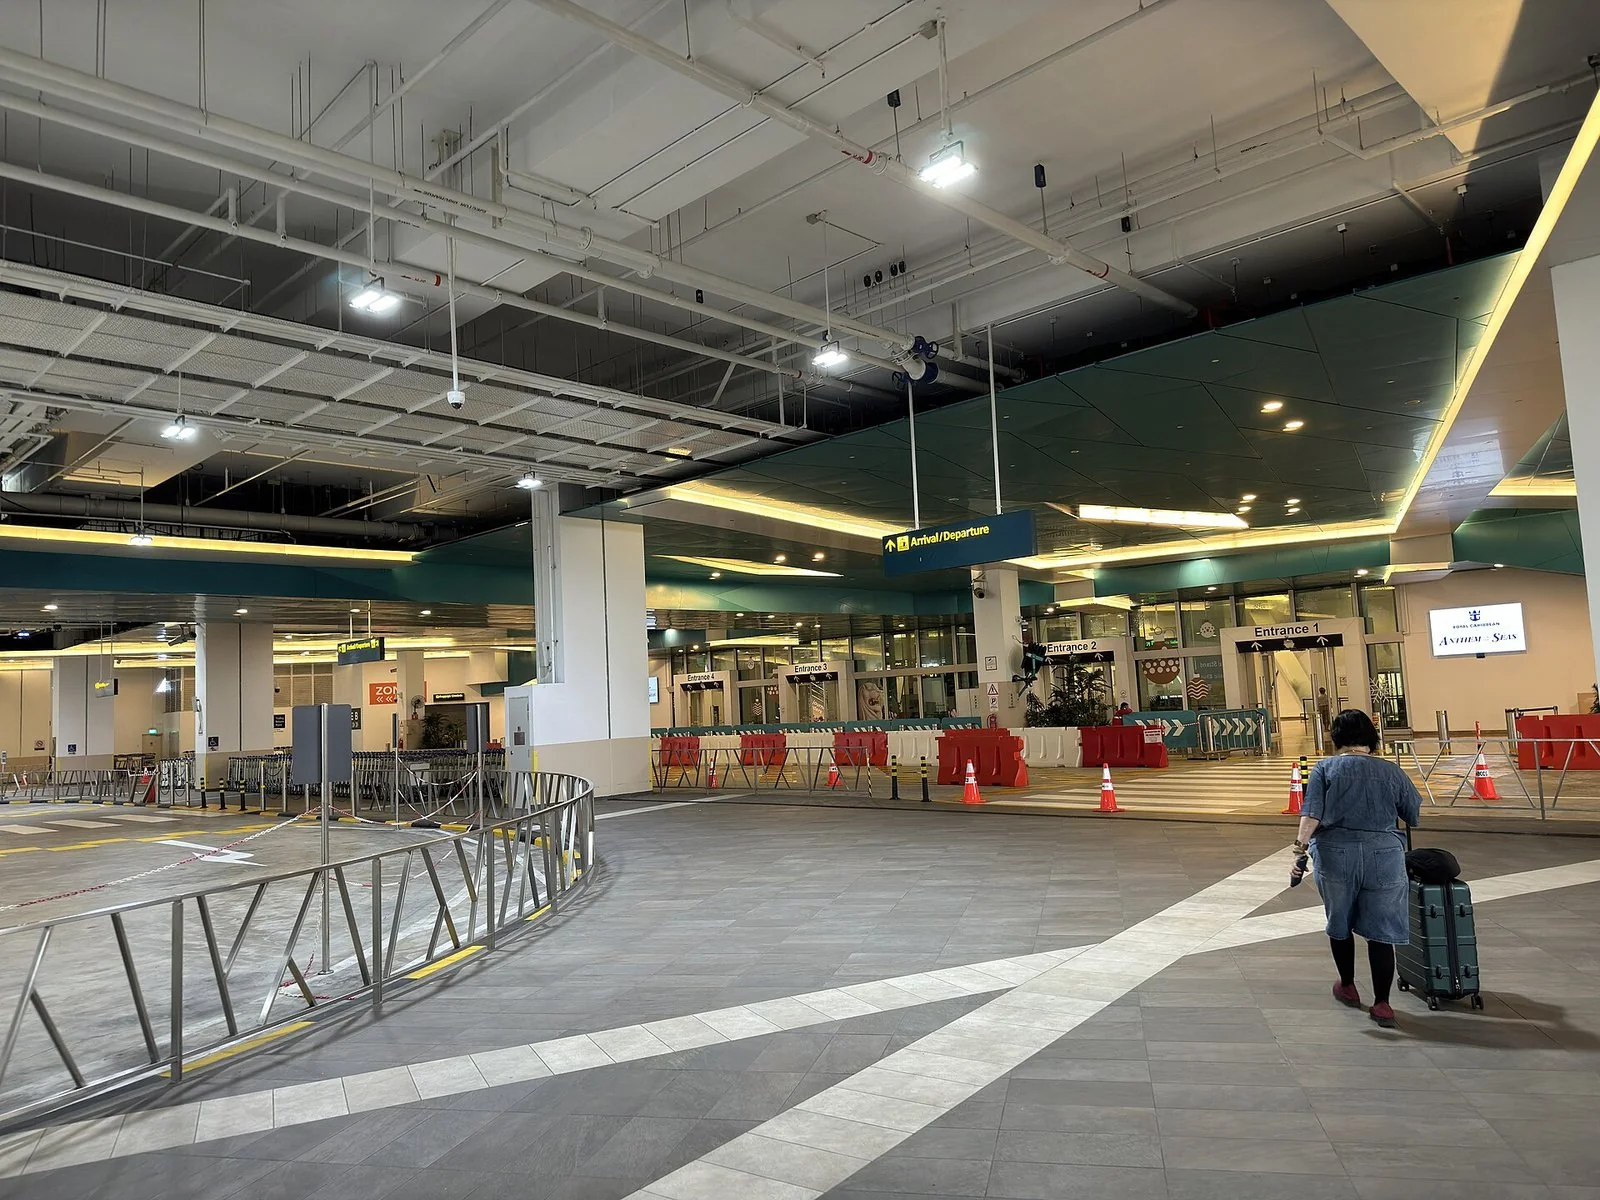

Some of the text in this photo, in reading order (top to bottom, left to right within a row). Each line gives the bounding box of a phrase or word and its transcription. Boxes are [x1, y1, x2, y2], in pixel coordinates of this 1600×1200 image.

[910, 525, 990, 548] Arrival/Departure
[1254, 622, 1319, 637] Entrance 1
[1047, 640, 1097, 652] Entrance 2
[794, 663, 828, 673] Entrance 3
[687, 673, 710, 681] Entrance
[375, 686, 397, 696] ZON
